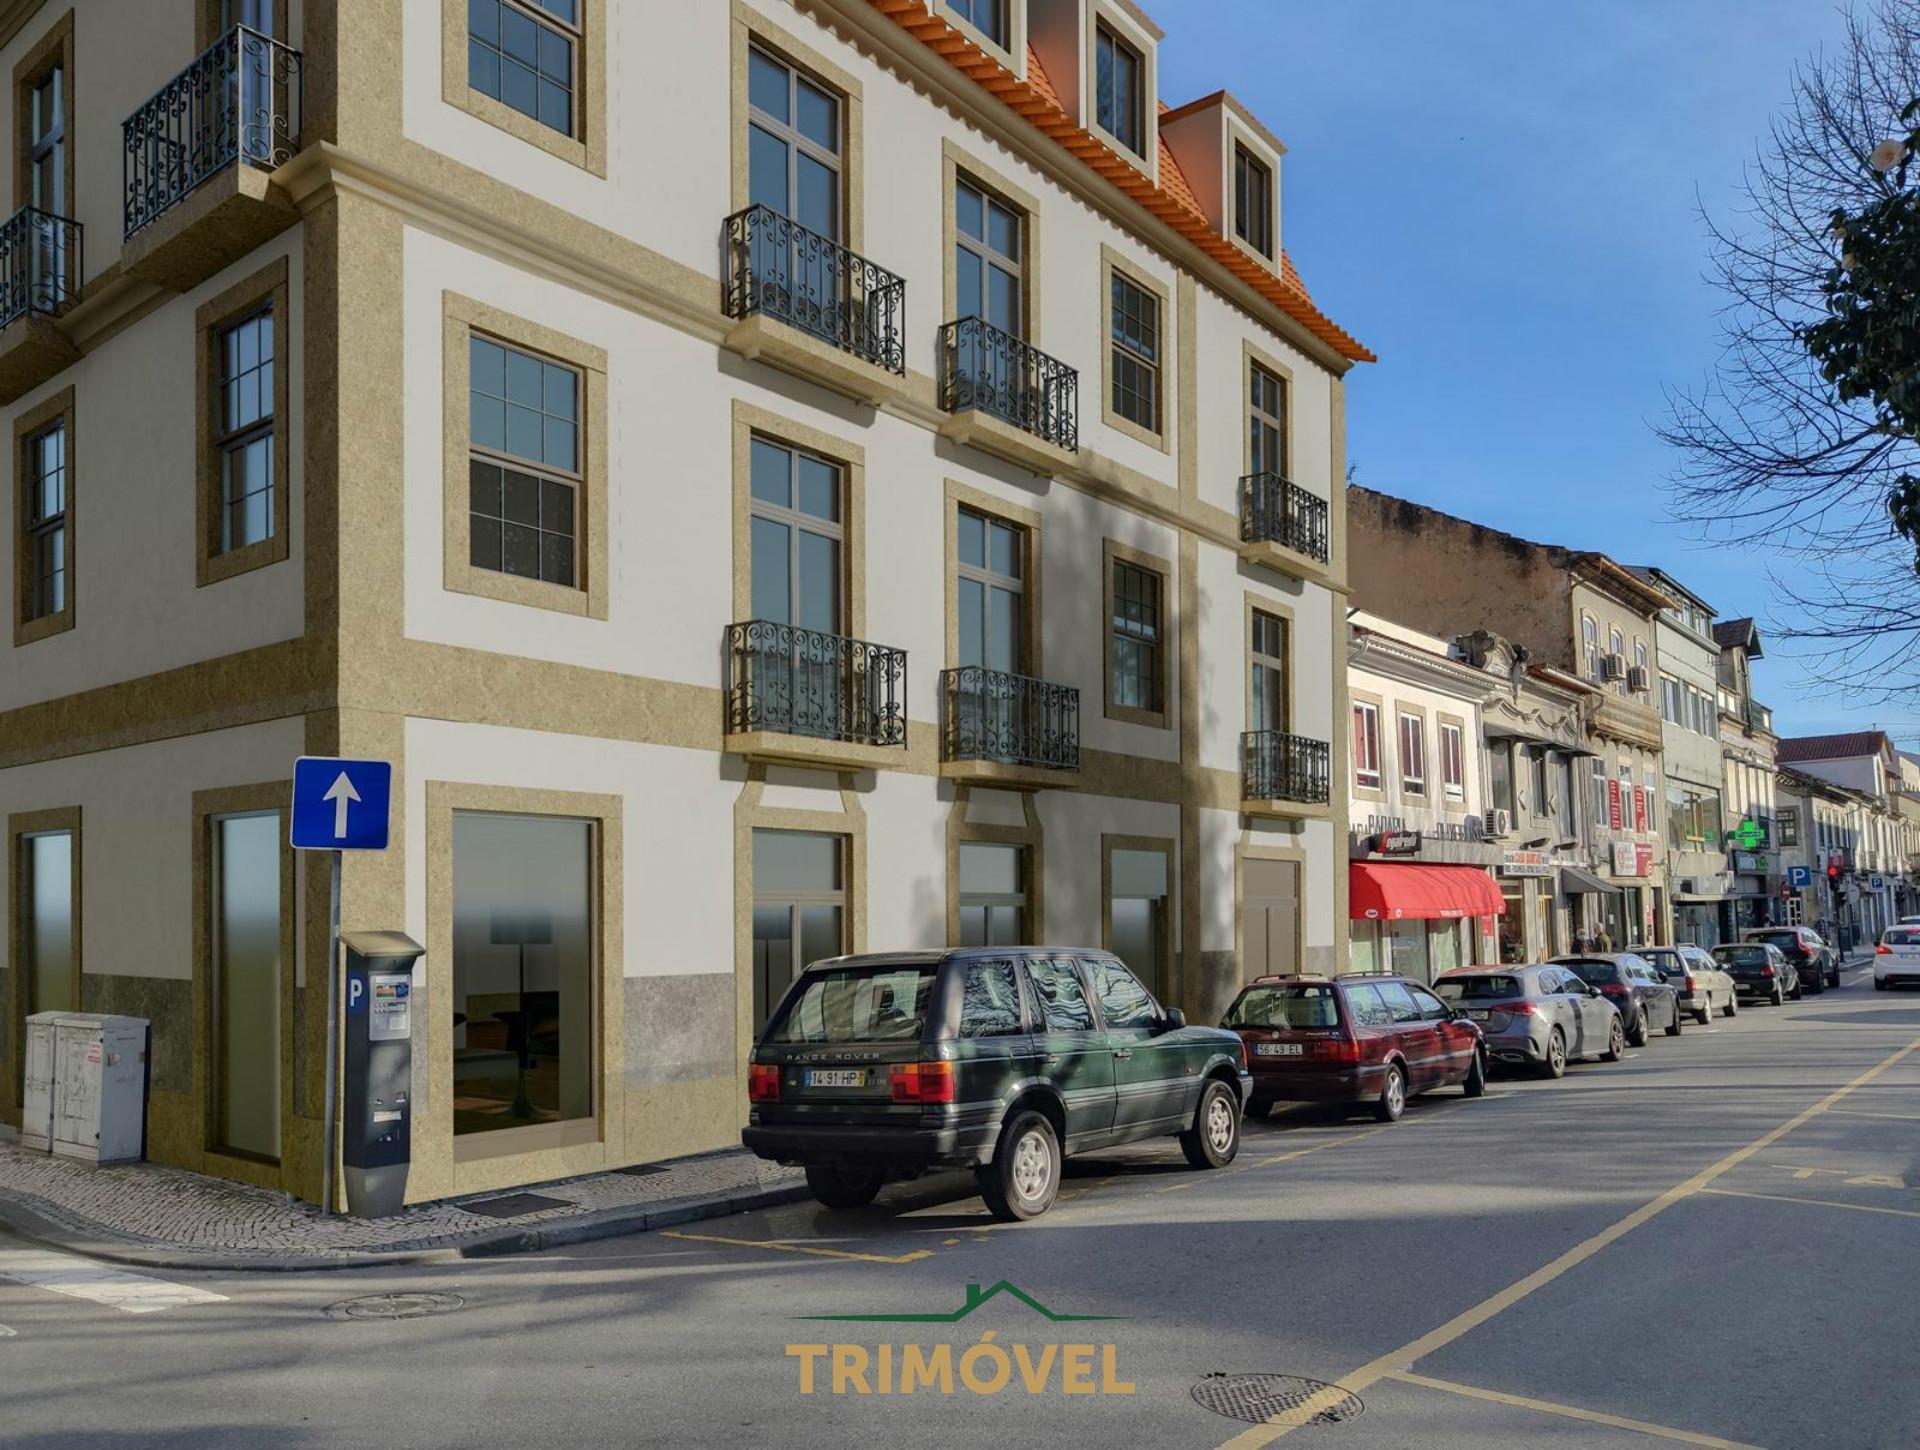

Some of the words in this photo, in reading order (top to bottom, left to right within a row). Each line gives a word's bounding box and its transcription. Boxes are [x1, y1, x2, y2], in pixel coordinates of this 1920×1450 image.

[1792, 868, 1806, 885] P
[350, 978, 363, 1008] P
[835, 1052, 880, 1060] ROVER
